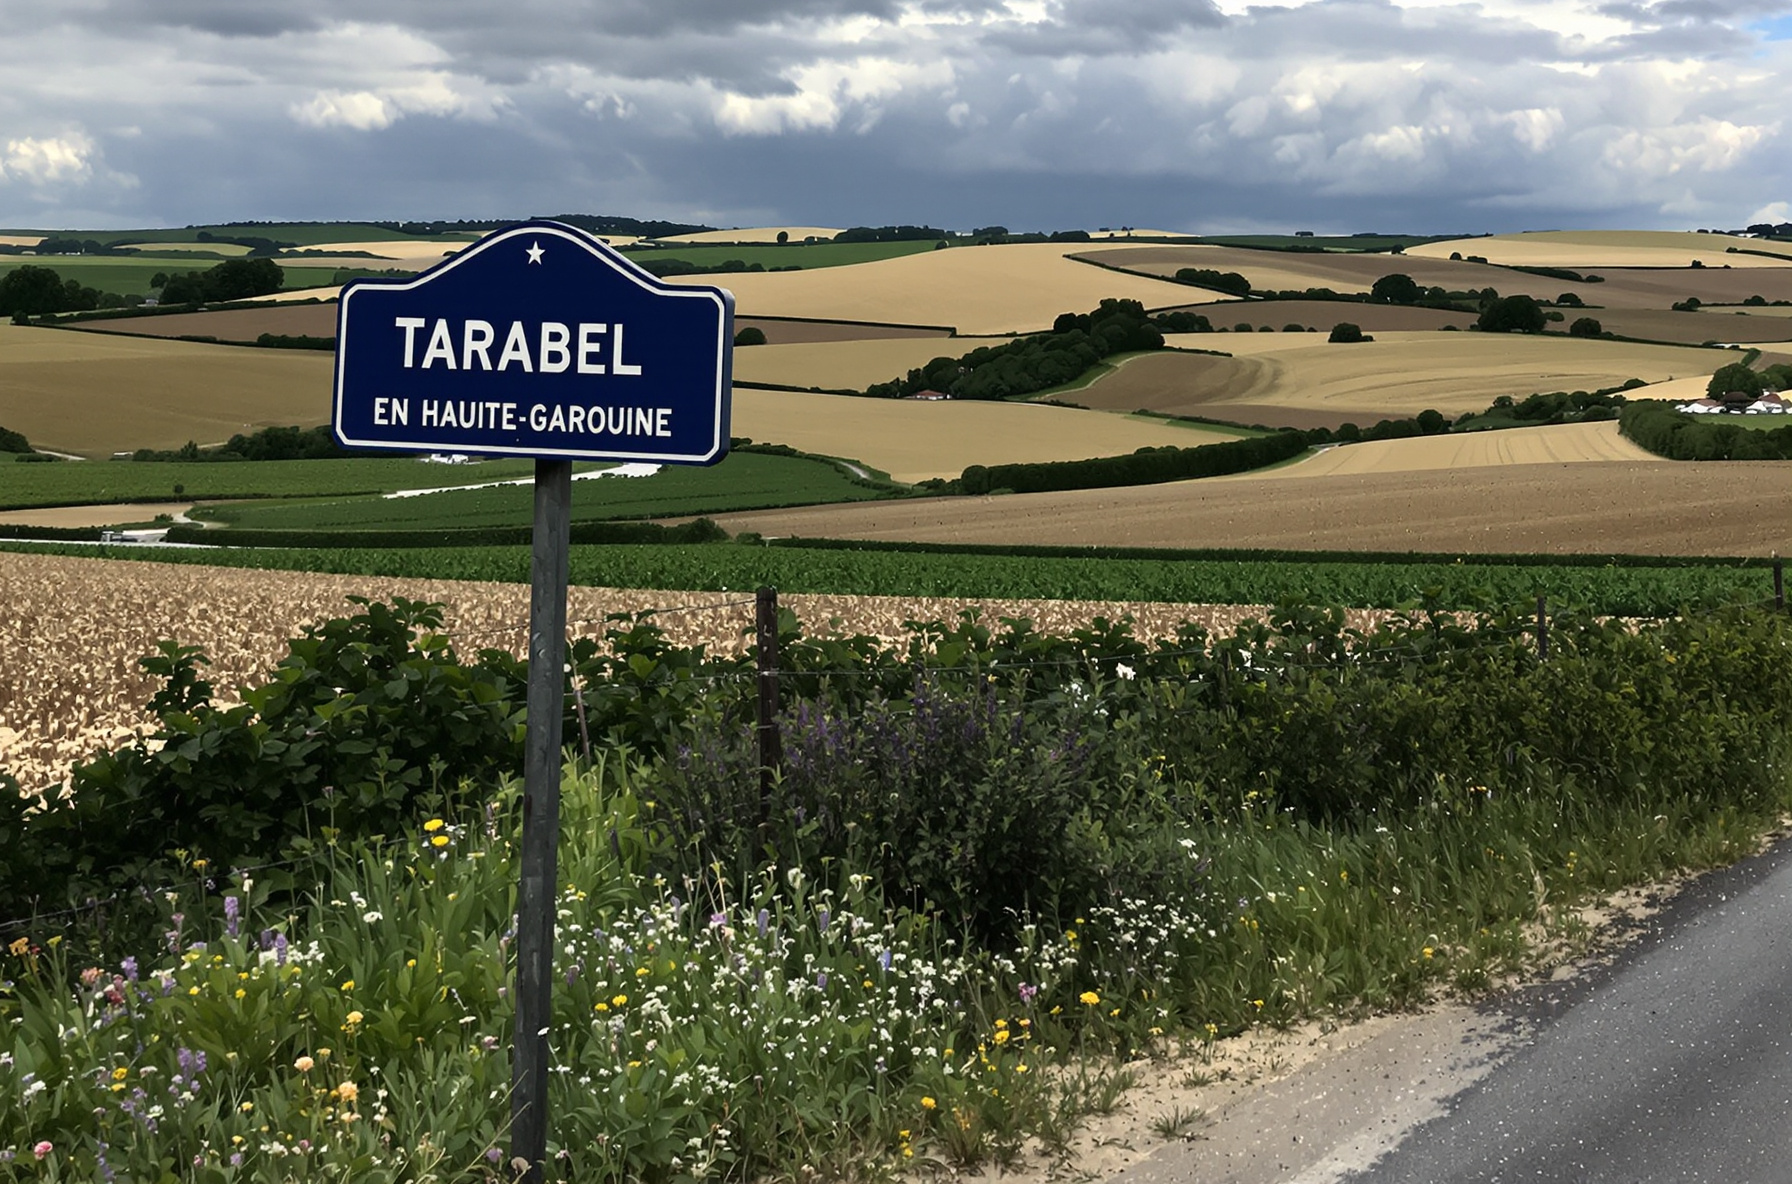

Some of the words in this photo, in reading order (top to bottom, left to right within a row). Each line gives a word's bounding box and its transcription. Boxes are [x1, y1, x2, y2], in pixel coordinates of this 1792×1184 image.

[395, 316, 642, 376] TARABEL
[373, 397, 409, 426] EN
[421, 399, 673, 437] HAUITE-GAROUINE
